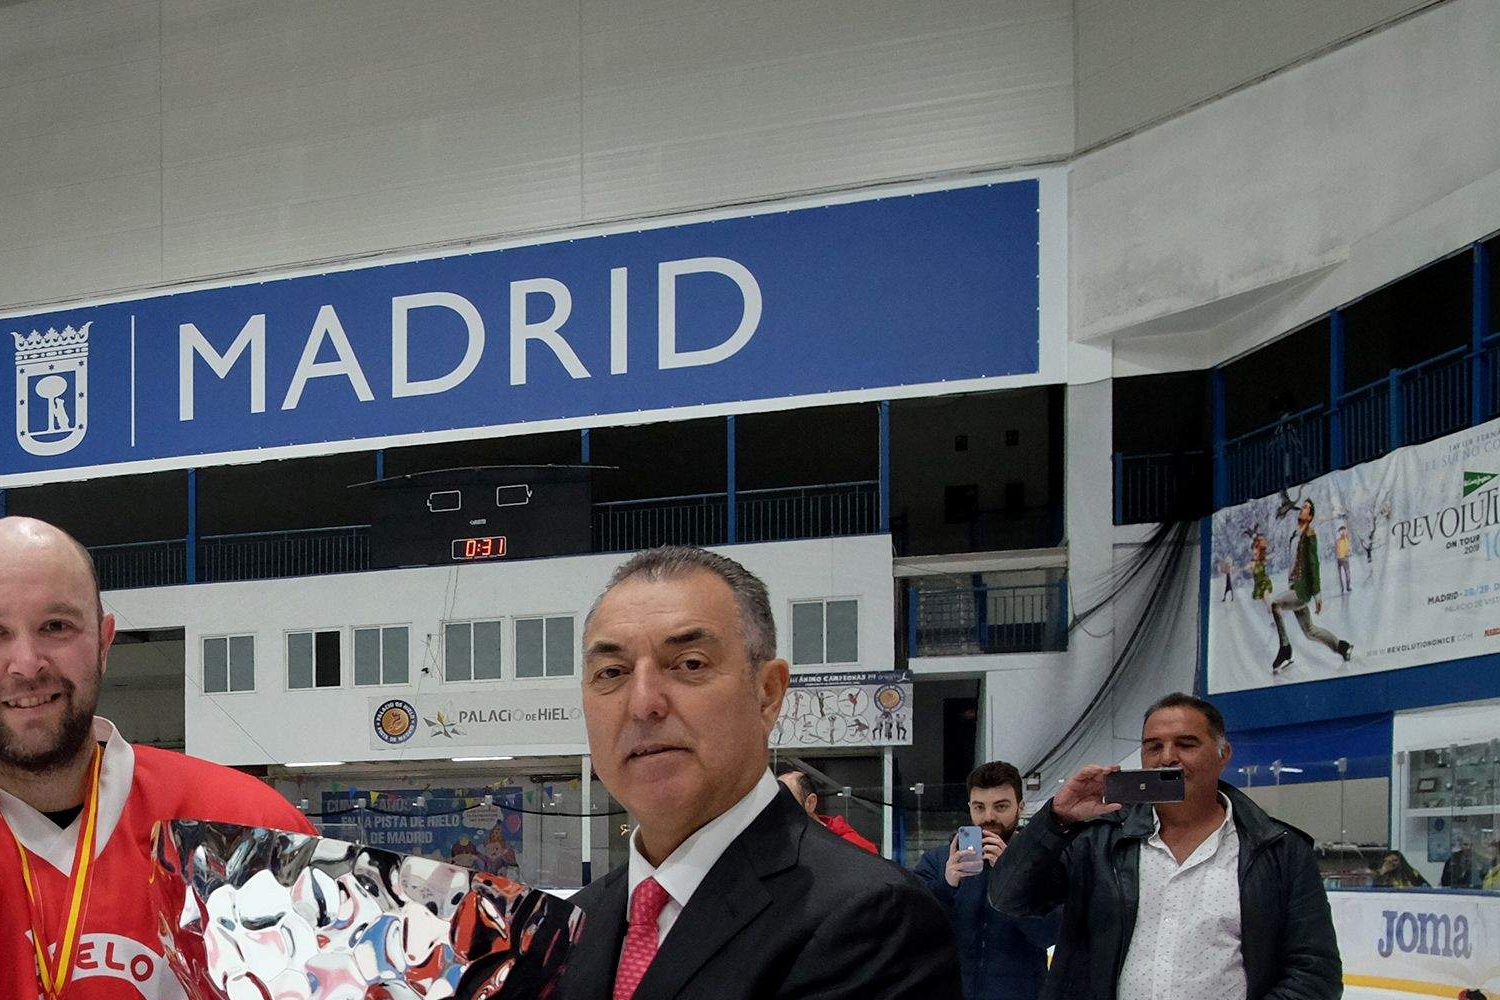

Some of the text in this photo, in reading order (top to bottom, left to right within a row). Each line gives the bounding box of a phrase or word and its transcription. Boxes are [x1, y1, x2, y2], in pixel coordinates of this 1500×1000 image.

[179, 256, 762, 421] MADRID
[466, 538, 504, 556] 0:31
[1460, 534, 1480, 547] TOUR
[1427, 591, 1459, 605] MADRID
[374, 815, 407, 828] PISTA
[409, 816, 425, 828] DE
[427, 815, 460, 827] HIELO
[370, 832, 385, 844] DE
[386, 831, 433, 844] MADRID
